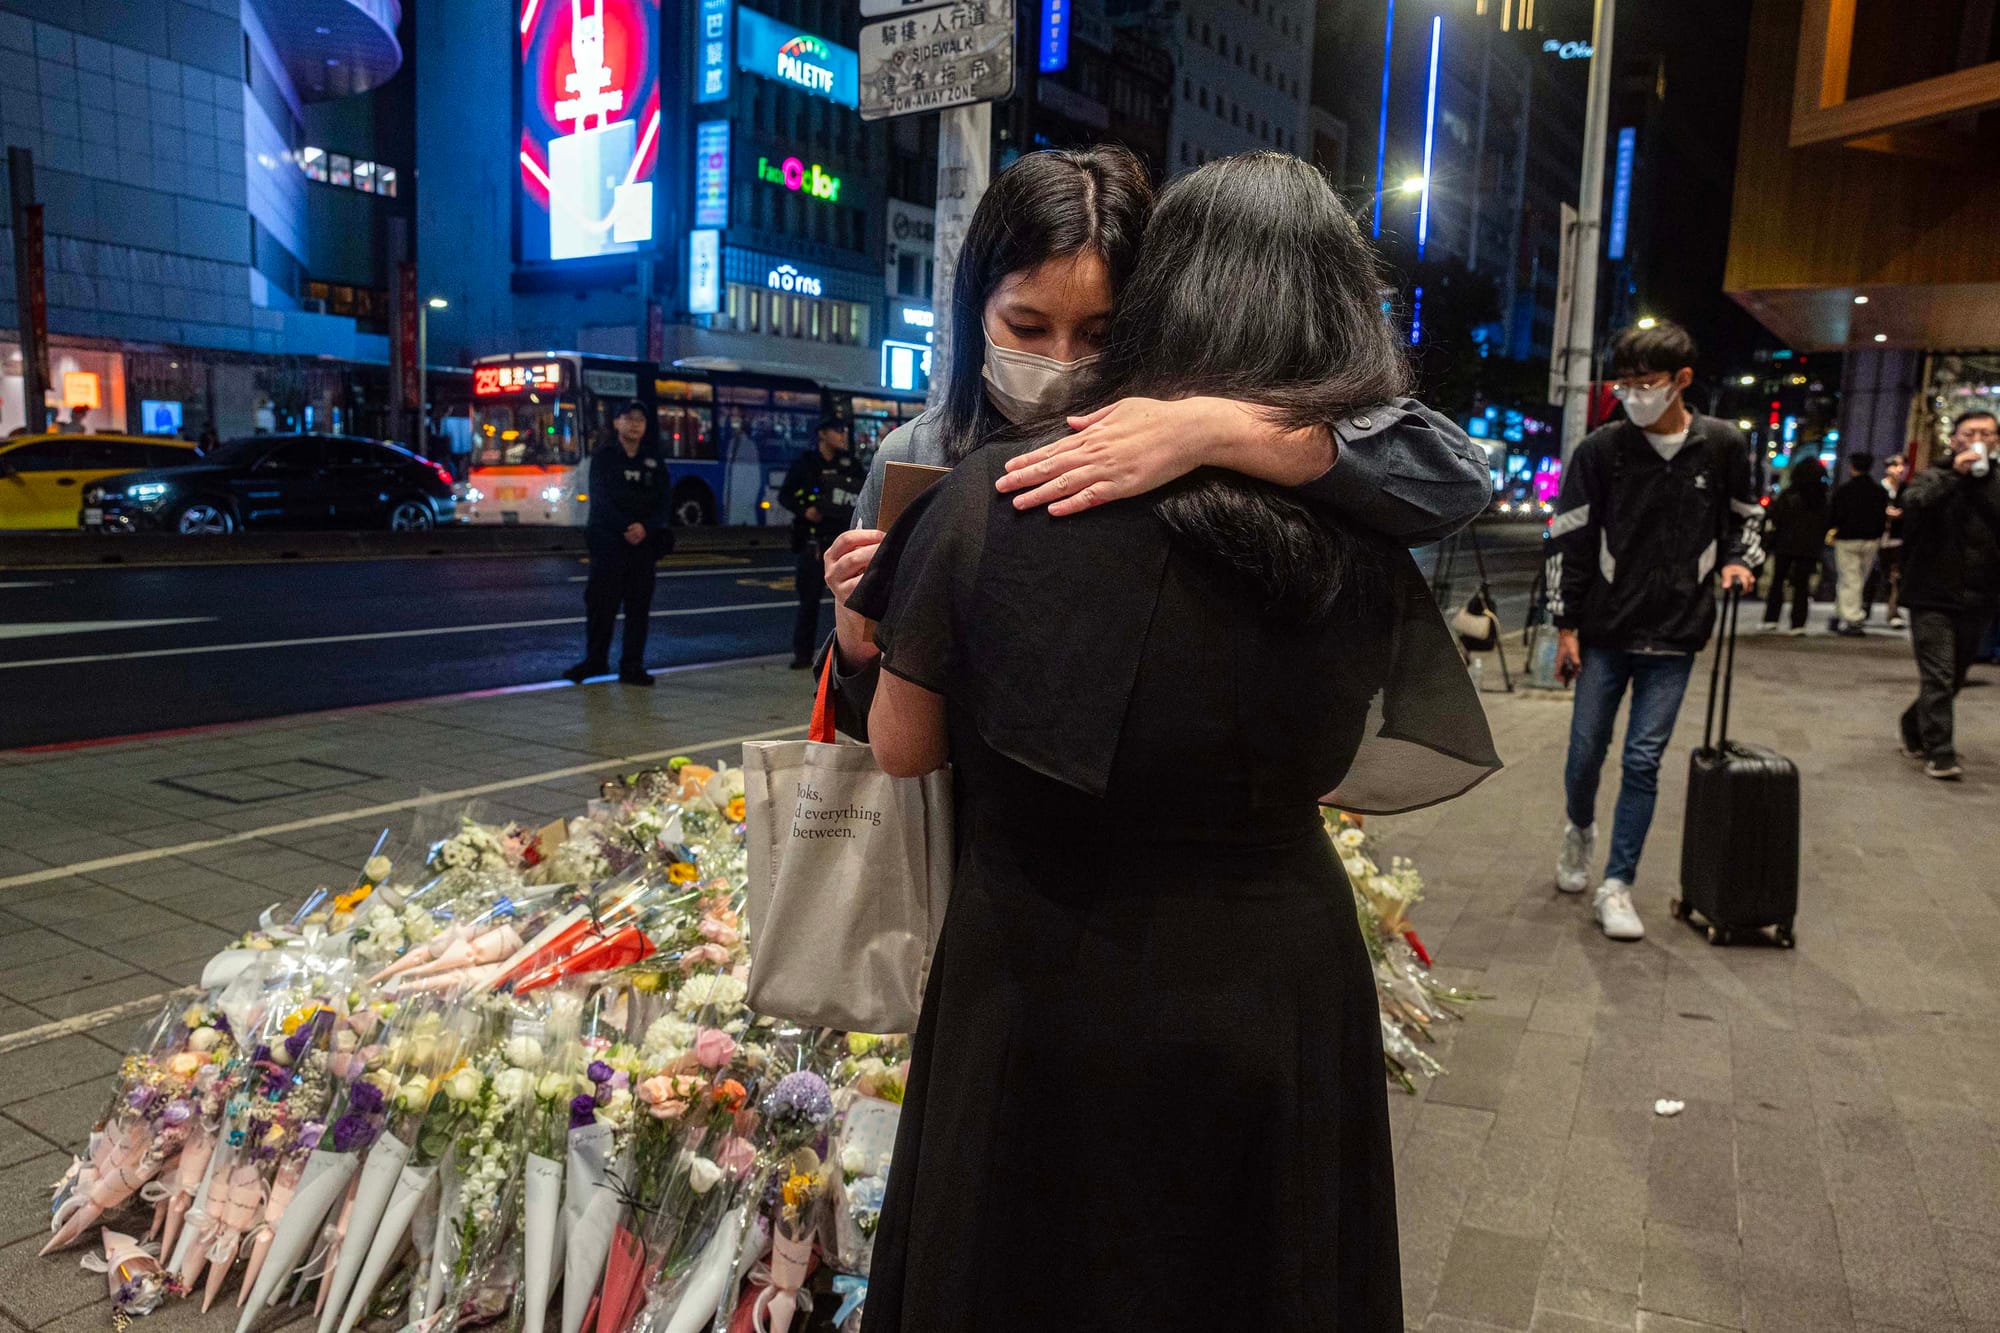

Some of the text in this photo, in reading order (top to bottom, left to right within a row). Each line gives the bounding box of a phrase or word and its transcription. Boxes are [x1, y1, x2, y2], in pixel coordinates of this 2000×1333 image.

[912, 36, 973, 62] SIDEWALK
[777, 52, 834, 93] PALETTE
[890, 83, 977, 111] TOW-AWAY ZONE
[804, 804, 882, 827] everything
[792, 821, 856, 839] between.
